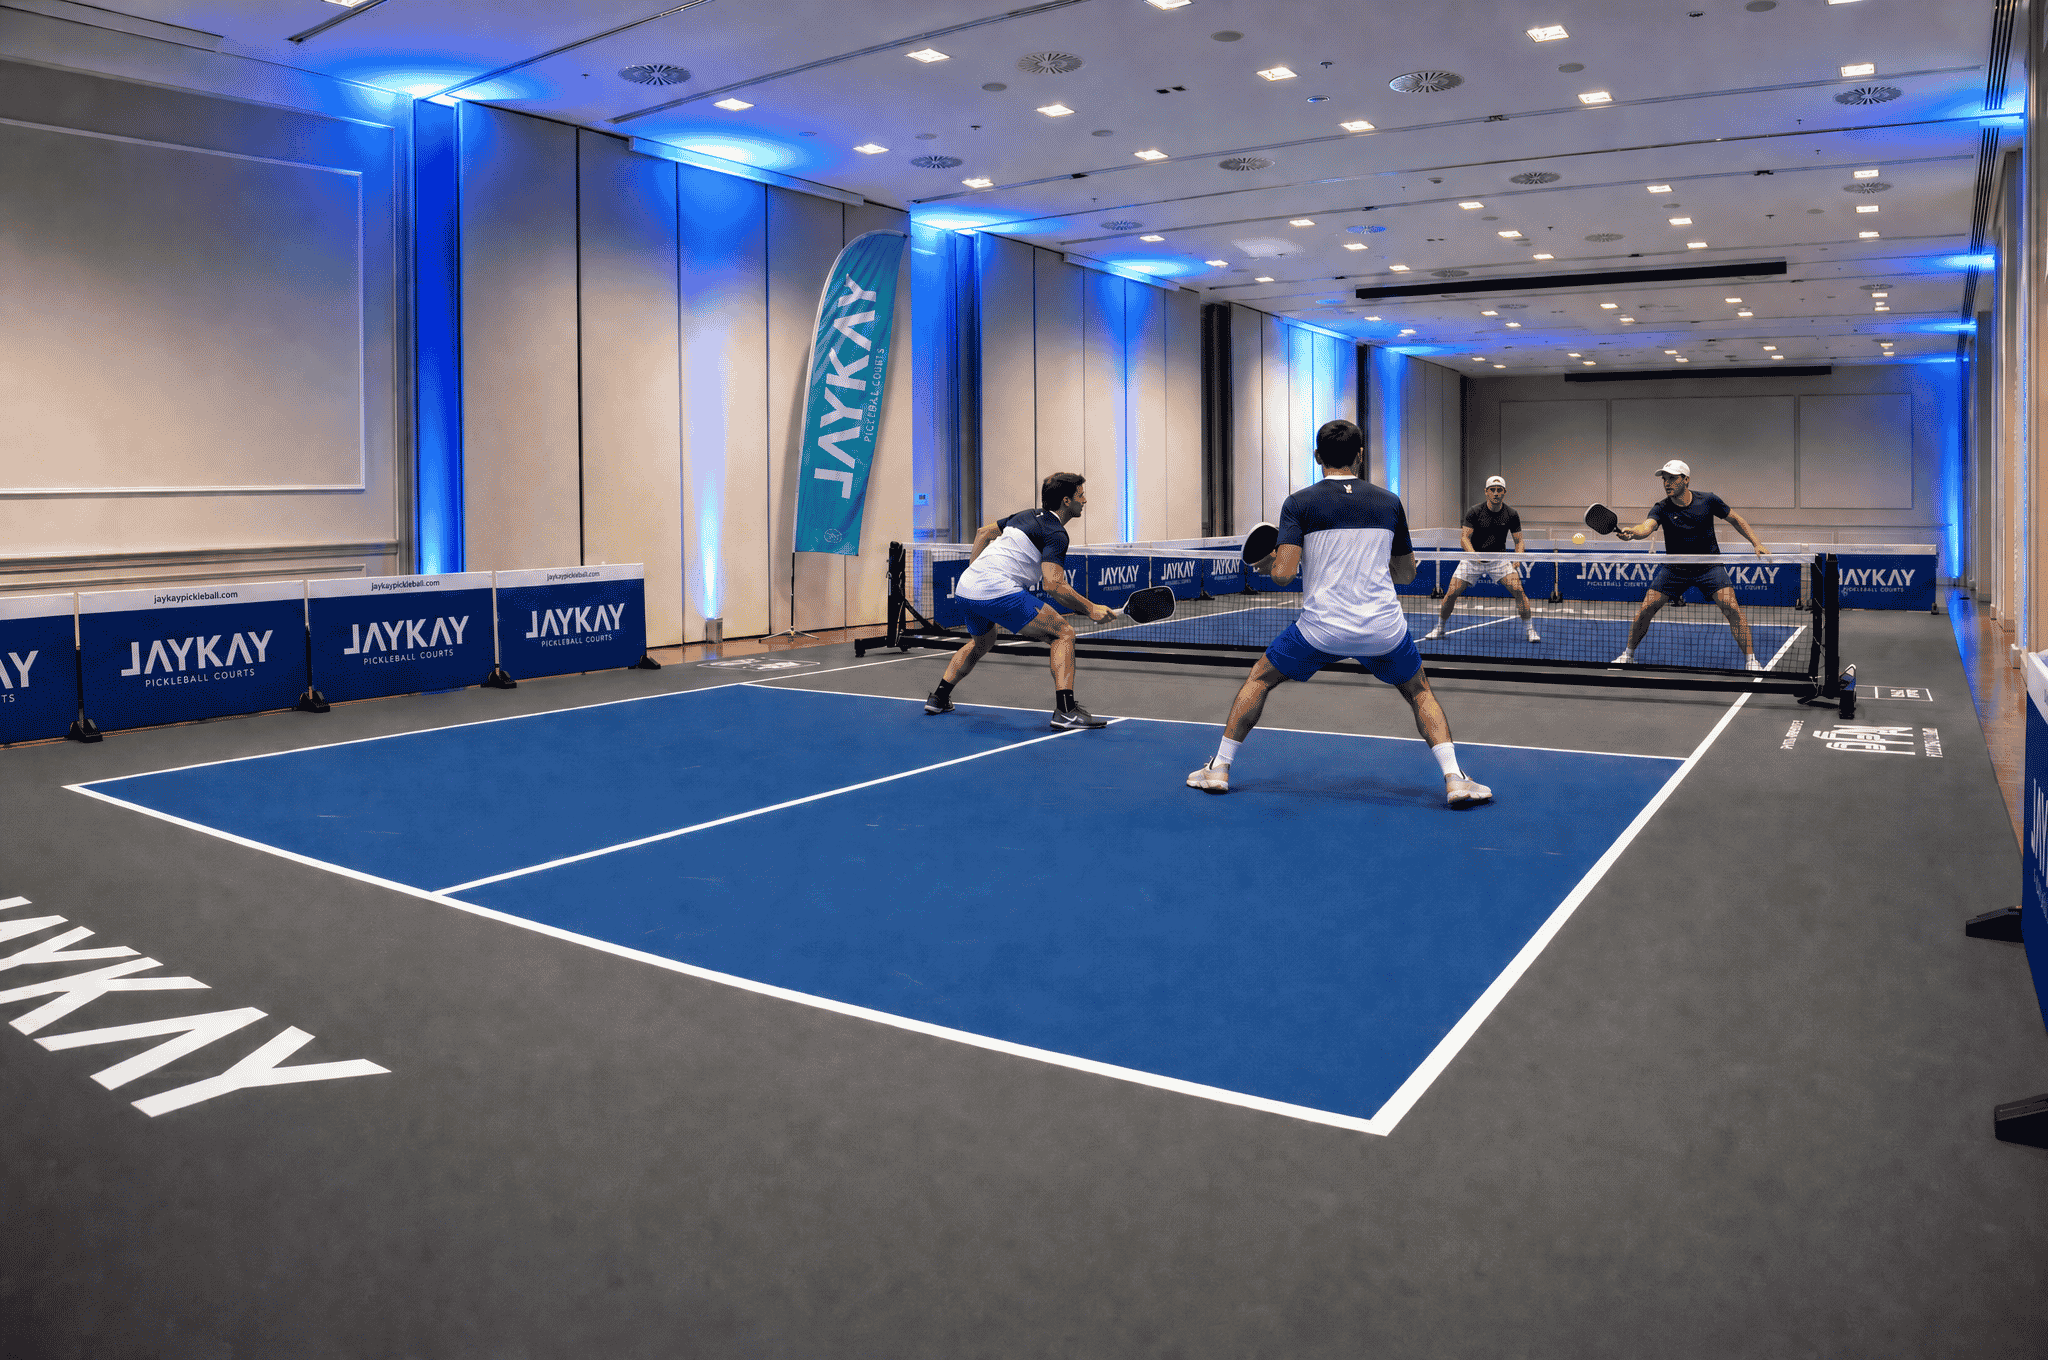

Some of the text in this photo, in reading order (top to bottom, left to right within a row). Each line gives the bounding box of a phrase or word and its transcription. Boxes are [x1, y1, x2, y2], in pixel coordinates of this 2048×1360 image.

[814, 273, 876, 499] JAYKAY
[547, 570, 600, 581] jaykaypickleball.com
[1098, 565, 1139, 585] JAYKAY
[1161, 560, 1195, 580] JAYKAY
[1576, 562, 1658, 580] JAYKAY
[371, 579, 440, 591] jaykaypickleball.com
[154, 591, 238, 604] jaykaypickleball.com
[526, 603, 625, 639] JAYKAY
[344, 615, 469, 655] JAYKAY
[541, 634, 612, 647] PICKLEBALL COURTS
[121, 630, 273, 676] JAYKAY
[364, 649, 454, 665] PICKLEBALL COURTS
[145, 668, 255, 687] PICKLEBALL COURTS
